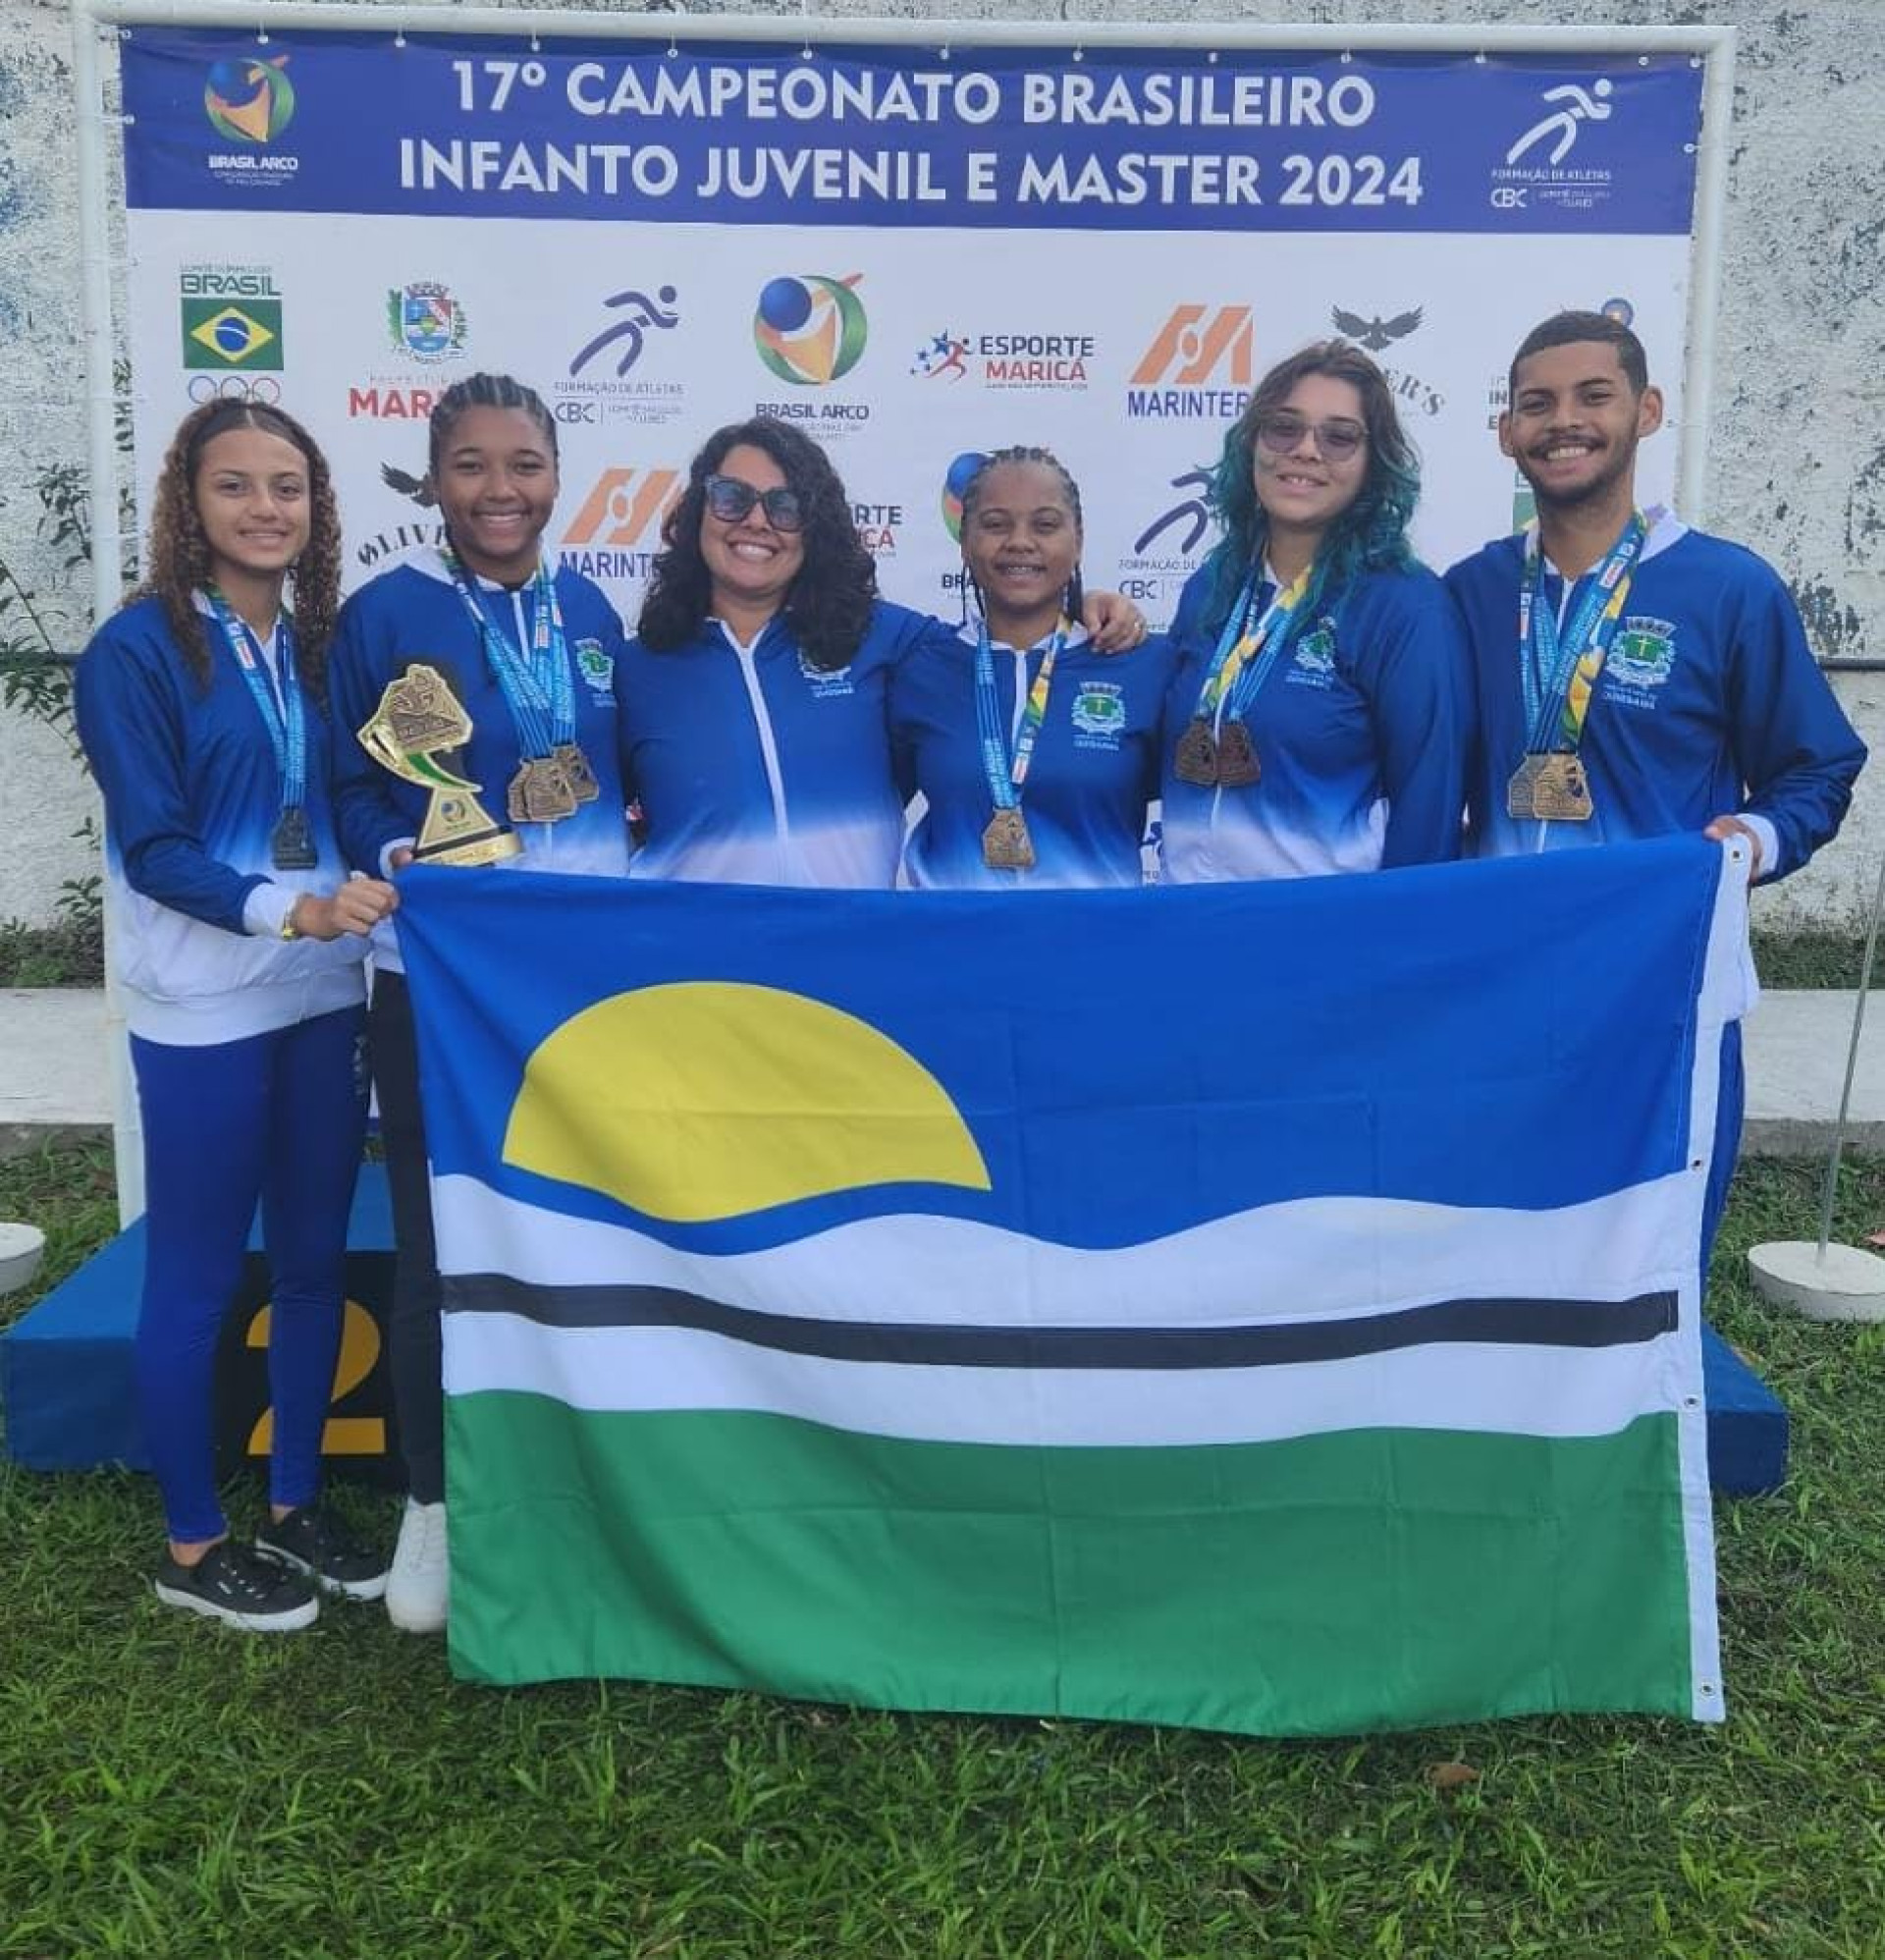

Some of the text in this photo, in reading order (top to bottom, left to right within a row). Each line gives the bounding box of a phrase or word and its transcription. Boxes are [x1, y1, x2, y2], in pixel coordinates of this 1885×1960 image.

[566, 62, 1001, 124] CAMPEONATO
[1023, 73, 1376, 128] BRASILEIRO
[208, 155, 298, 170] BRASIL ARCO
[400, 138, 1424, 206] INFANTO JUVENIL E MASTER 2024
[1490, 189, 1528, 207] CBC
[181, 274, 283, 296] BRASIL
[980, 336, 1095, 356] ESPORTE
[986, 358, 1087, 381] MARICÁ
[350, 388, 438, 417] MAR
[555, 402, 595, 423] CBC
[755, 403, 870, 420] BRASIL ARCO
[560, 551, 651, 578] MARINT
[1118, 579, 1158, 600] CBC
[245, 1298, 387, 1455] 2
